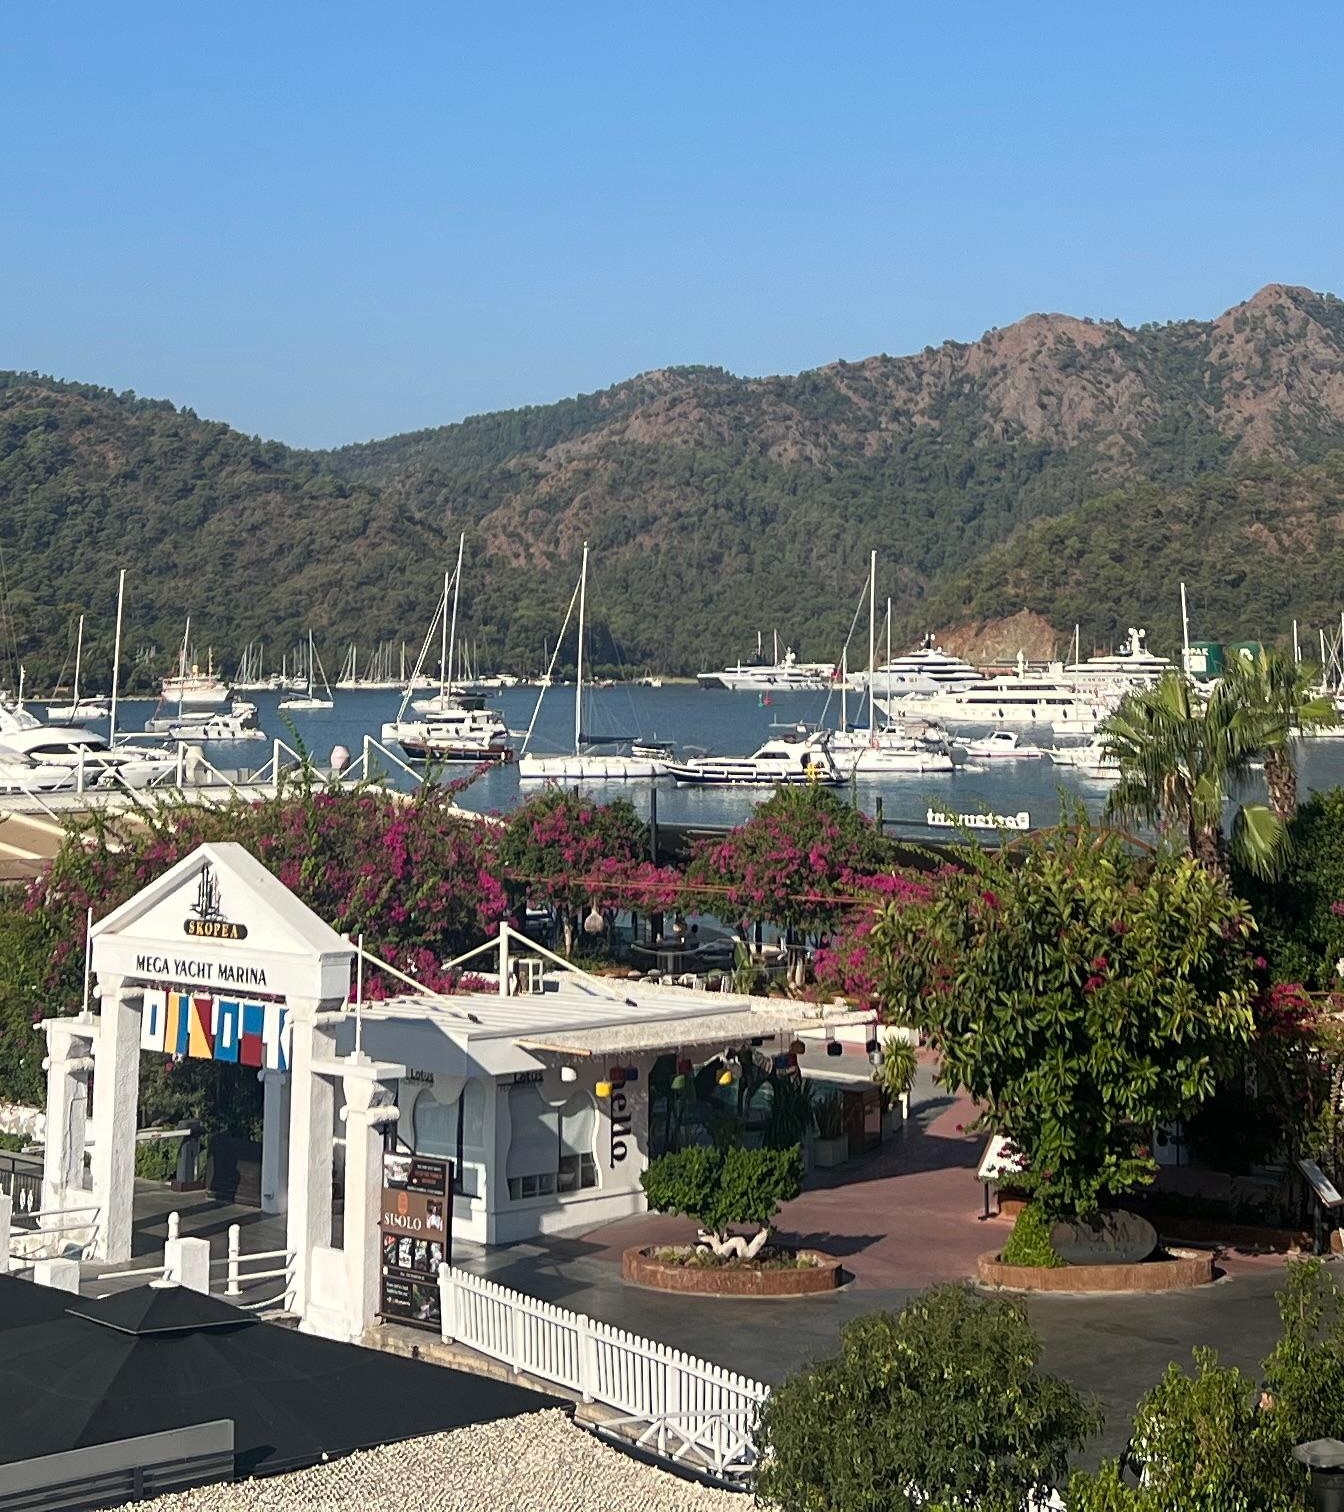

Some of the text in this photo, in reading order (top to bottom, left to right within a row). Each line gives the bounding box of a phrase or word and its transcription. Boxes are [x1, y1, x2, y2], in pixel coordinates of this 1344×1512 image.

[188, 920, 239, 938] SKOPEA
[136, 955, 267, 986] MEGA YACHT MARINA
[410, 1068, 434, 1083] Lotus
[384, 1212, 422, 1231] SUOLO
